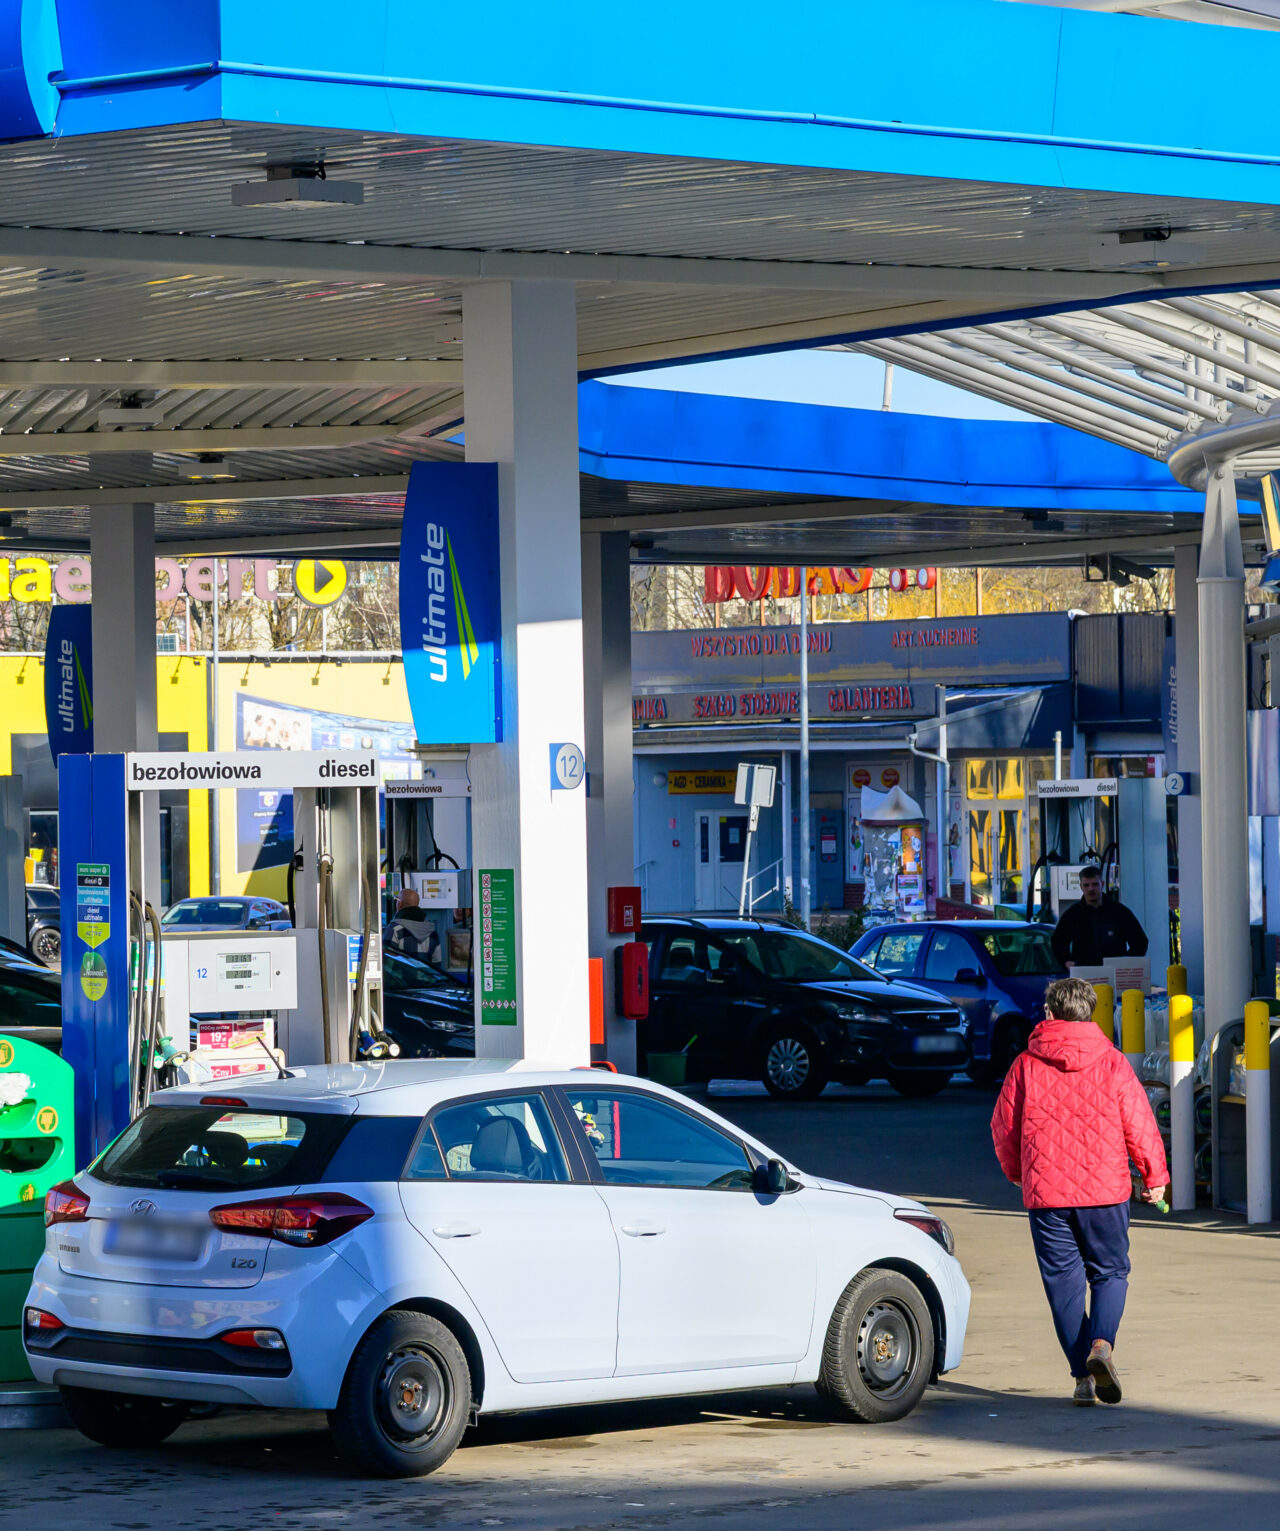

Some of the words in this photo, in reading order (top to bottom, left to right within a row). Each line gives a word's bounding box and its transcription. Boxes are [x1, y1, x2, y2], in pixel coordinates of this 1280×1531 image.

[420, 522, 448, 683] ultimate
[691, 635, 761, 658] WSZYSTKO
[763, 633, 791, 655] DLA
[891, 631, 916, 649] ART.
[918, 627, 979, 647] KUCHENNE
[57, 639, 74, 733] ultimate
[694, 695, 735, 717] SZKŁO
[739, 691, 798, 715] STOŁOWE
[828, 686, 913, 712] GALANTERIA
[133, 761, 262, 782] bezołowiowa
[318, 759, 376, 778] diesel
[560, 755, 578, 778] 12
[386, 784, 443, 795] bezołowiowa
[1038, 784, 1080, 795] bezołowiowa
[1096, 782, 1117, 793] diesel
[1170, 779, 1179, 790] 2
[197, 968, 208, 979] 12
[210, 1032, 221, 1043] 19
